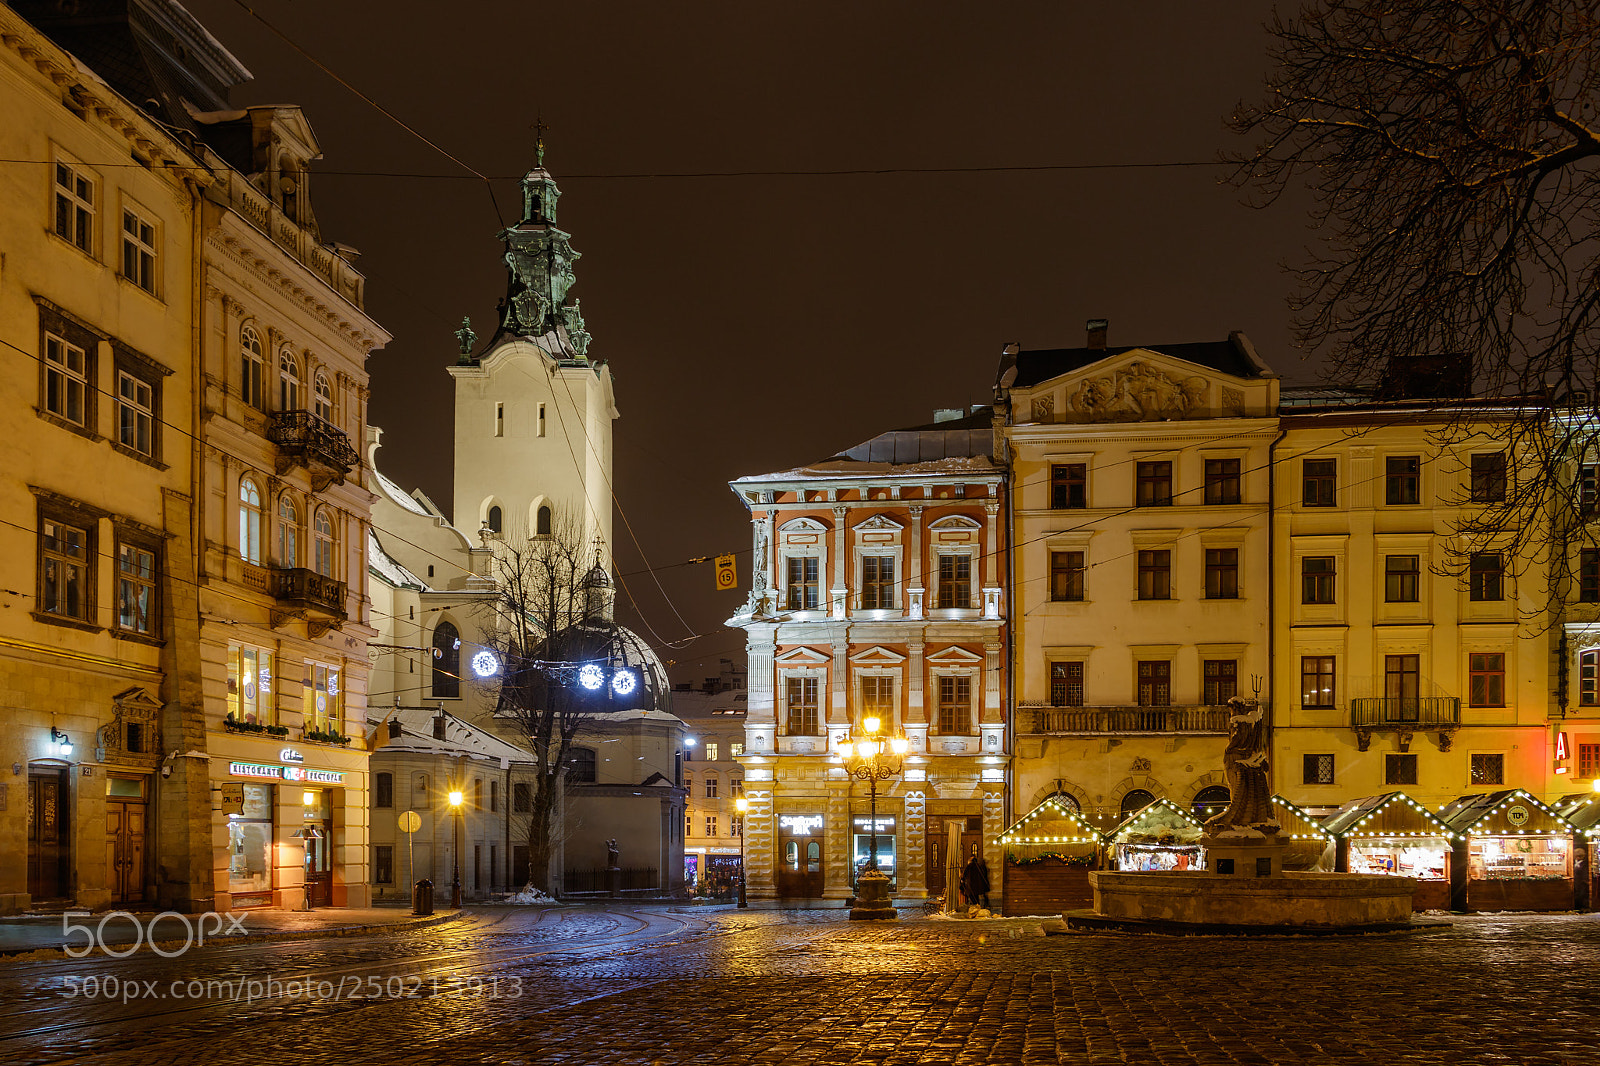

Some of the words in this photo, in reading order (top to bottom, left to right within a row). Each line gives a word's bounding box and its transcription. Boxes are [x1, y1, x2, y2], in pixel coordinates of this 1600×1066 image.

[721, 573, 731, 582] 15
[1556, 731, 1567, 761] A
[84, 767, 91, 775] 21
[232, 764, 281, 776] RISTORANTE
[309, 771, 343, 782] РЕСТОРАН
